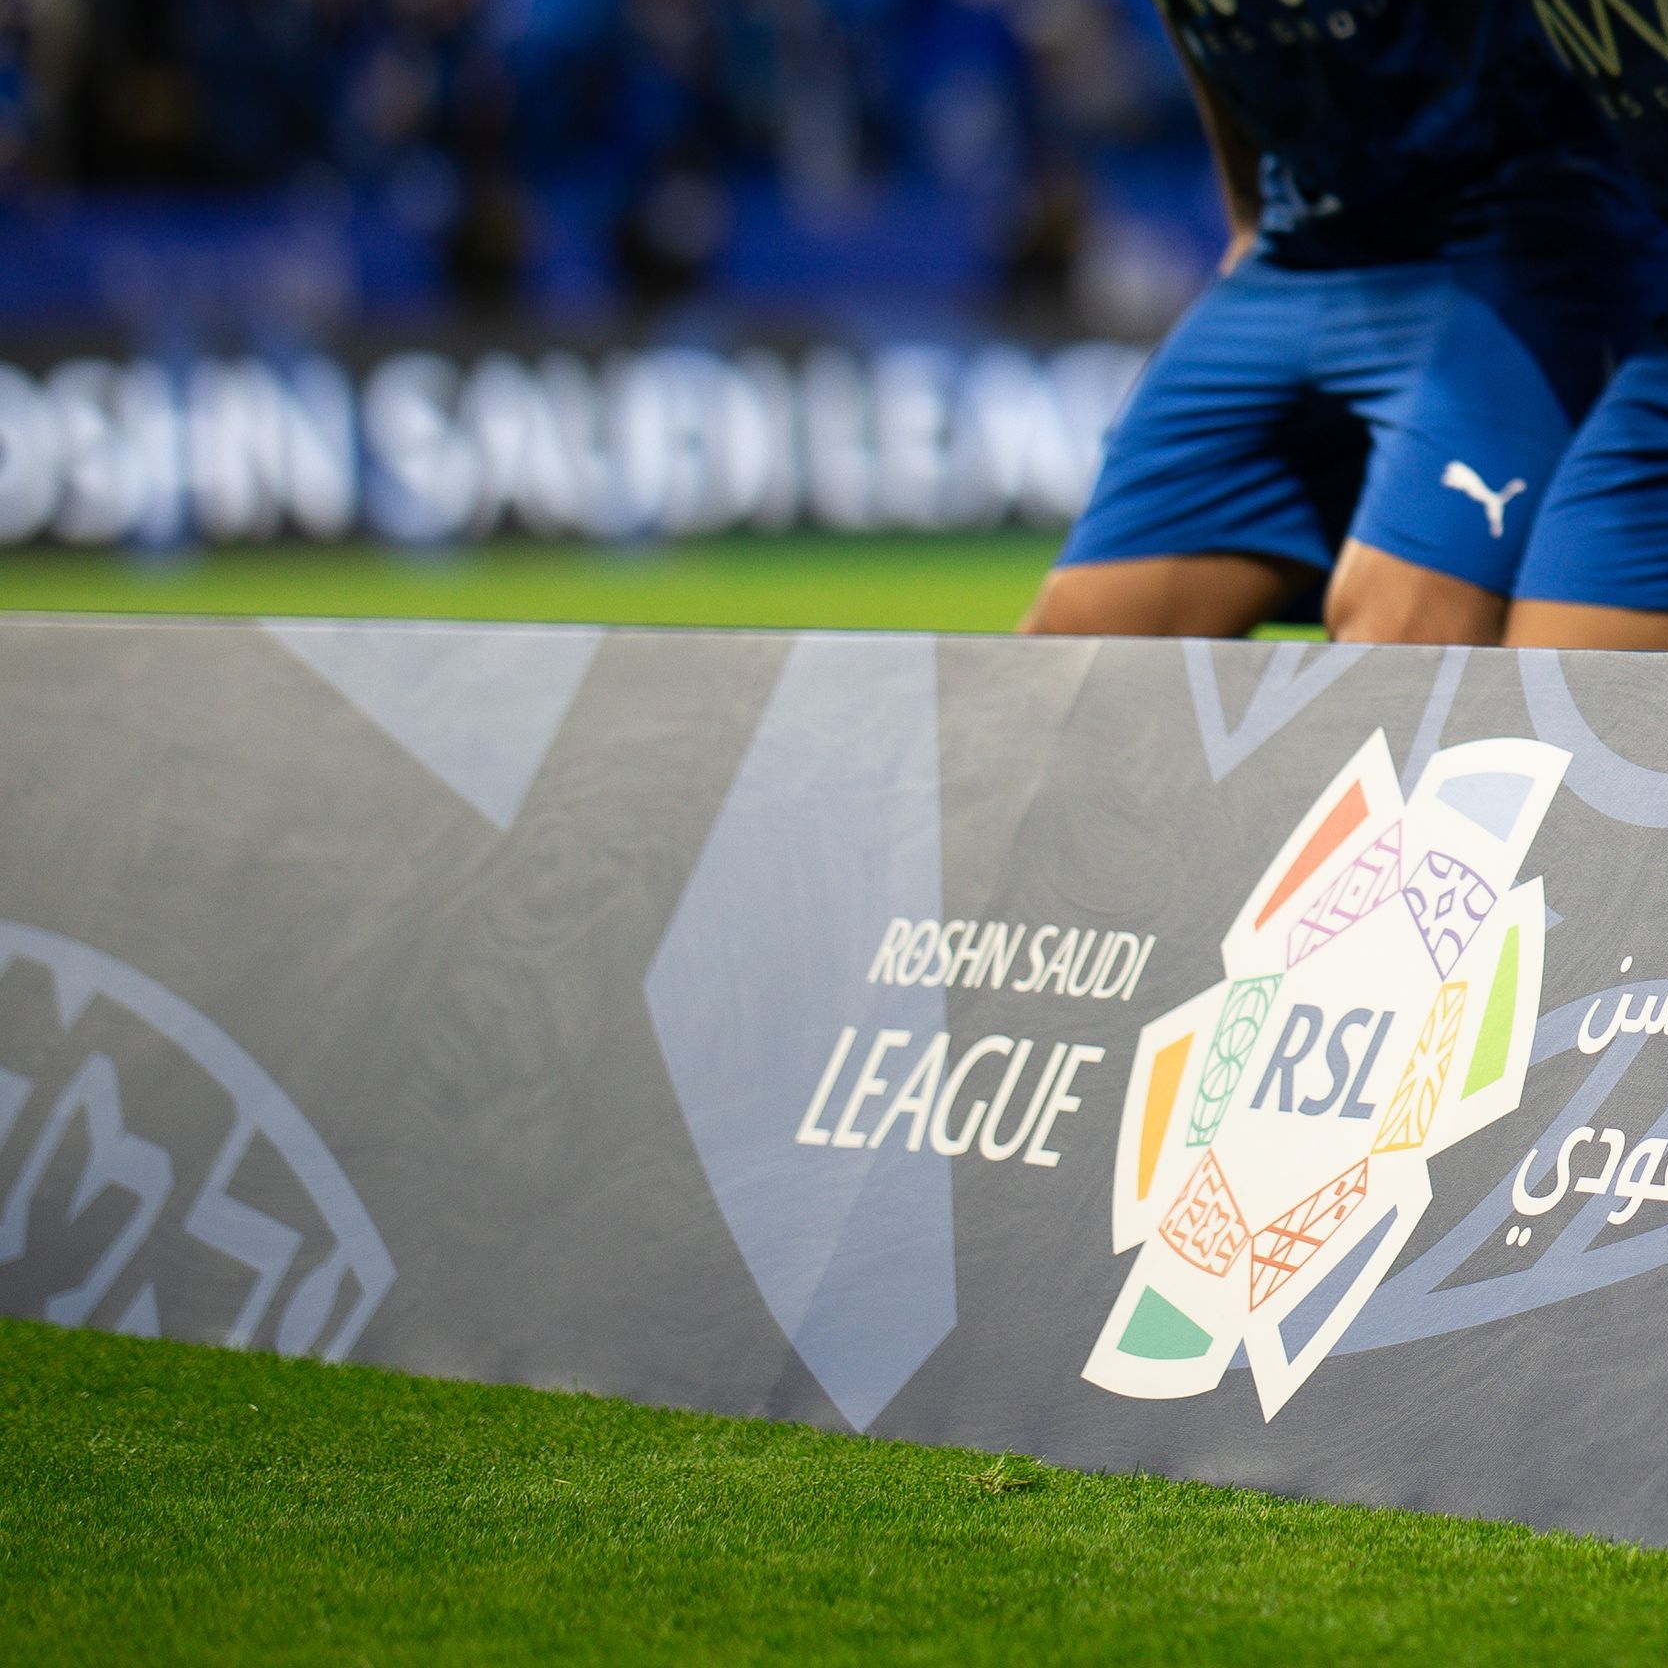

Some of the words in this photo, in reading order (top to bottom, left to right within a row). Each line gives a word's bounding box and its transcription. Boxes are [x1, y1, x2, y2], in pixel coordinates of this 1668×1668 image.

[866, 917, 1027, 990] ROSHN
[1012, 924, 1157, 1002] SAUDI
[794, 1025, 1107, 1168] LEAGUE
[1249, 1003, 1398, 1122] RSL
